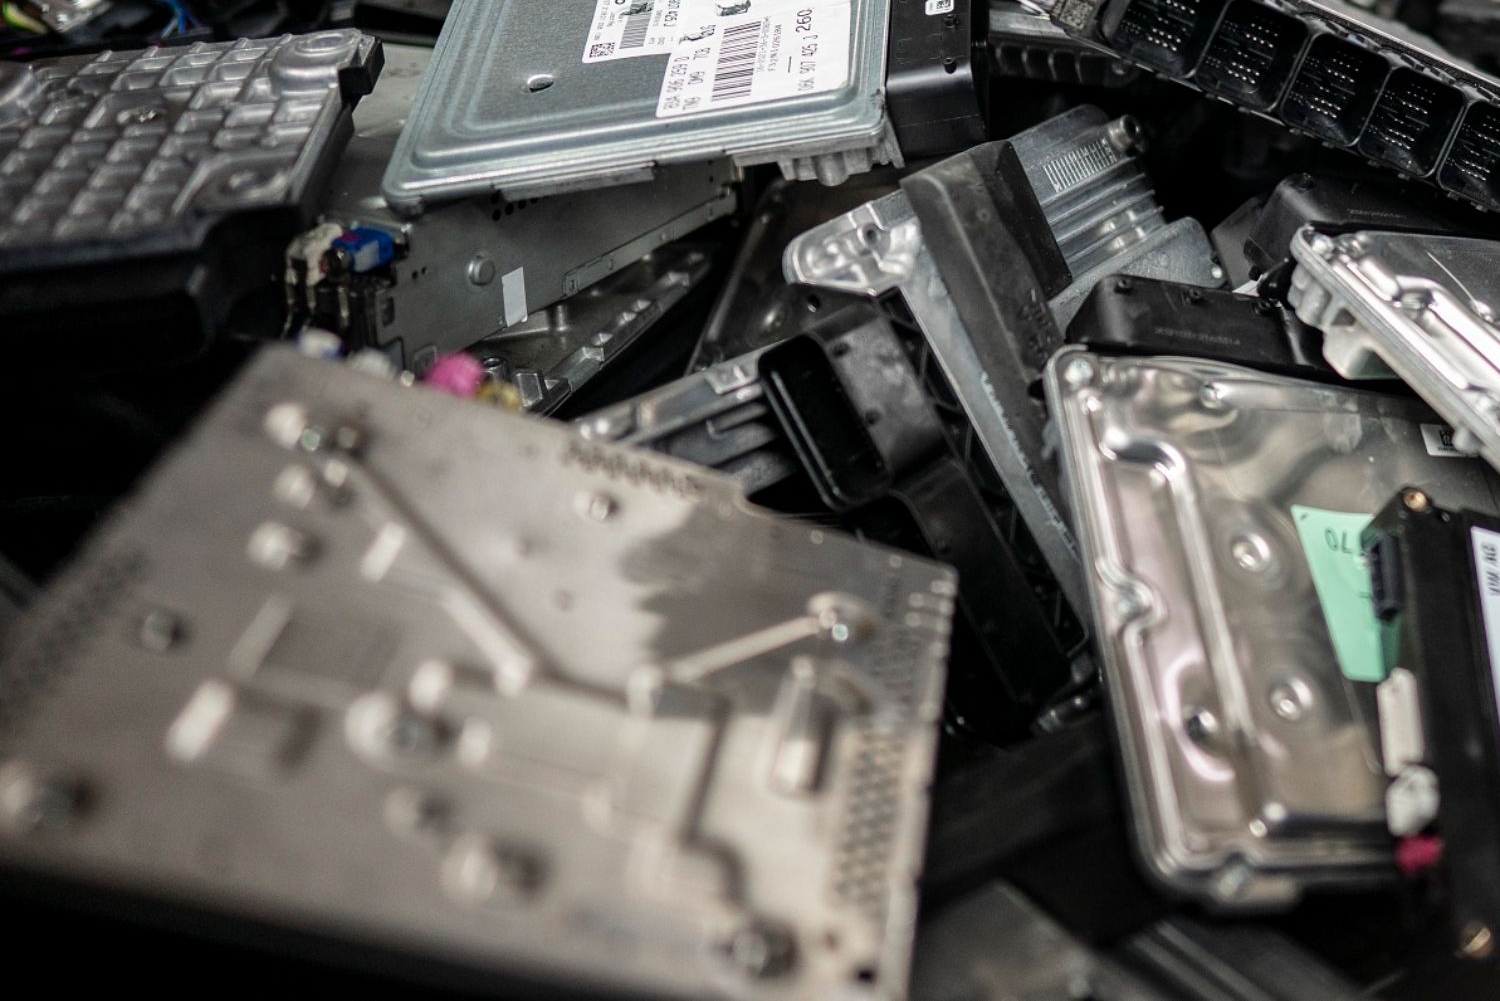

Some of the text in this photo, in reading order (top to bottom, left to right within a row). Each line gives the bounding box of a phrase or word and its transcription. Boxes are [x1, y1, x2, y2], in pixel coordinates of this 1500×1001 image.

[795, 9, 813, 33] 260
[801, 43, 818, 56] 425
[799, 61, 816, 74] 907
